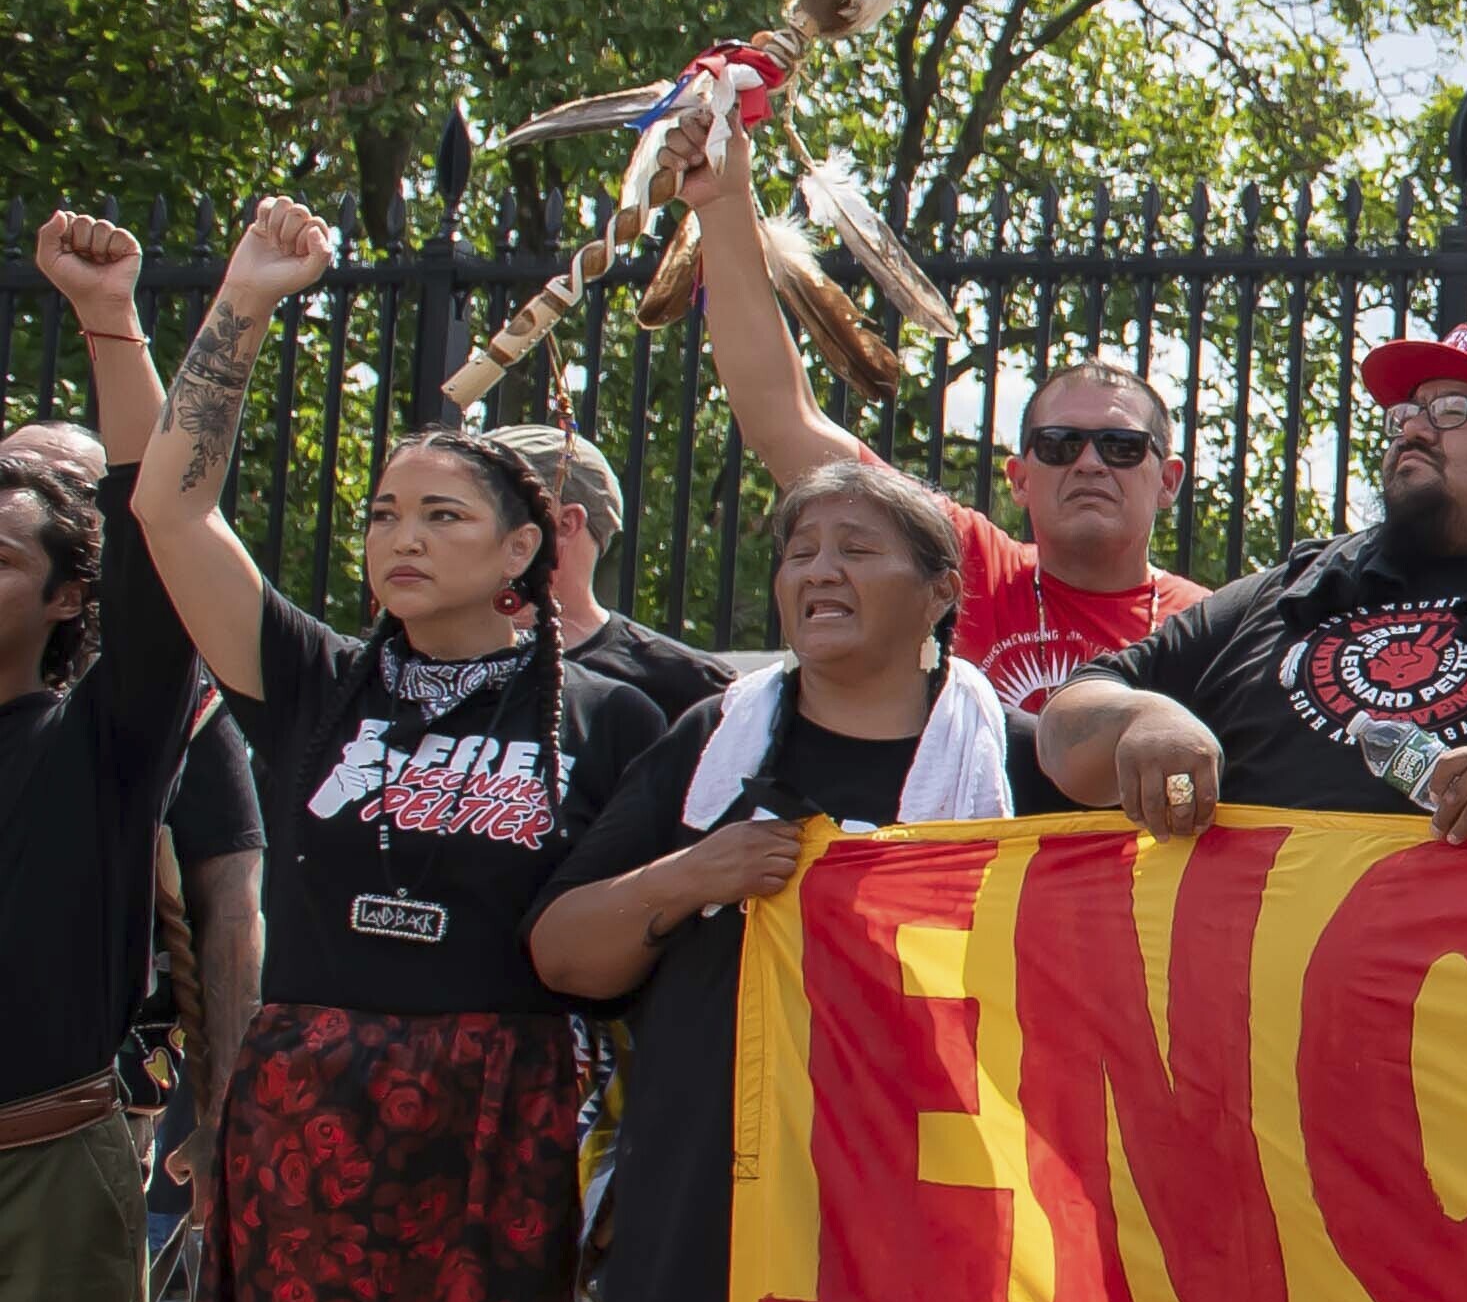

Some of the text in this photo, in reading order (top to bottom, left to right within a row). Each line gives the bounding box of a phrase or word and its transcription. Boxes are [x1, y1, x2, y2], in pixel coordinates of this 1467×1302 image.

[1356, 624, 1422, 644] FREE
[1340, 645, 1413, 708] LEONARD
[360, 785, 554, 849] PELTIER
